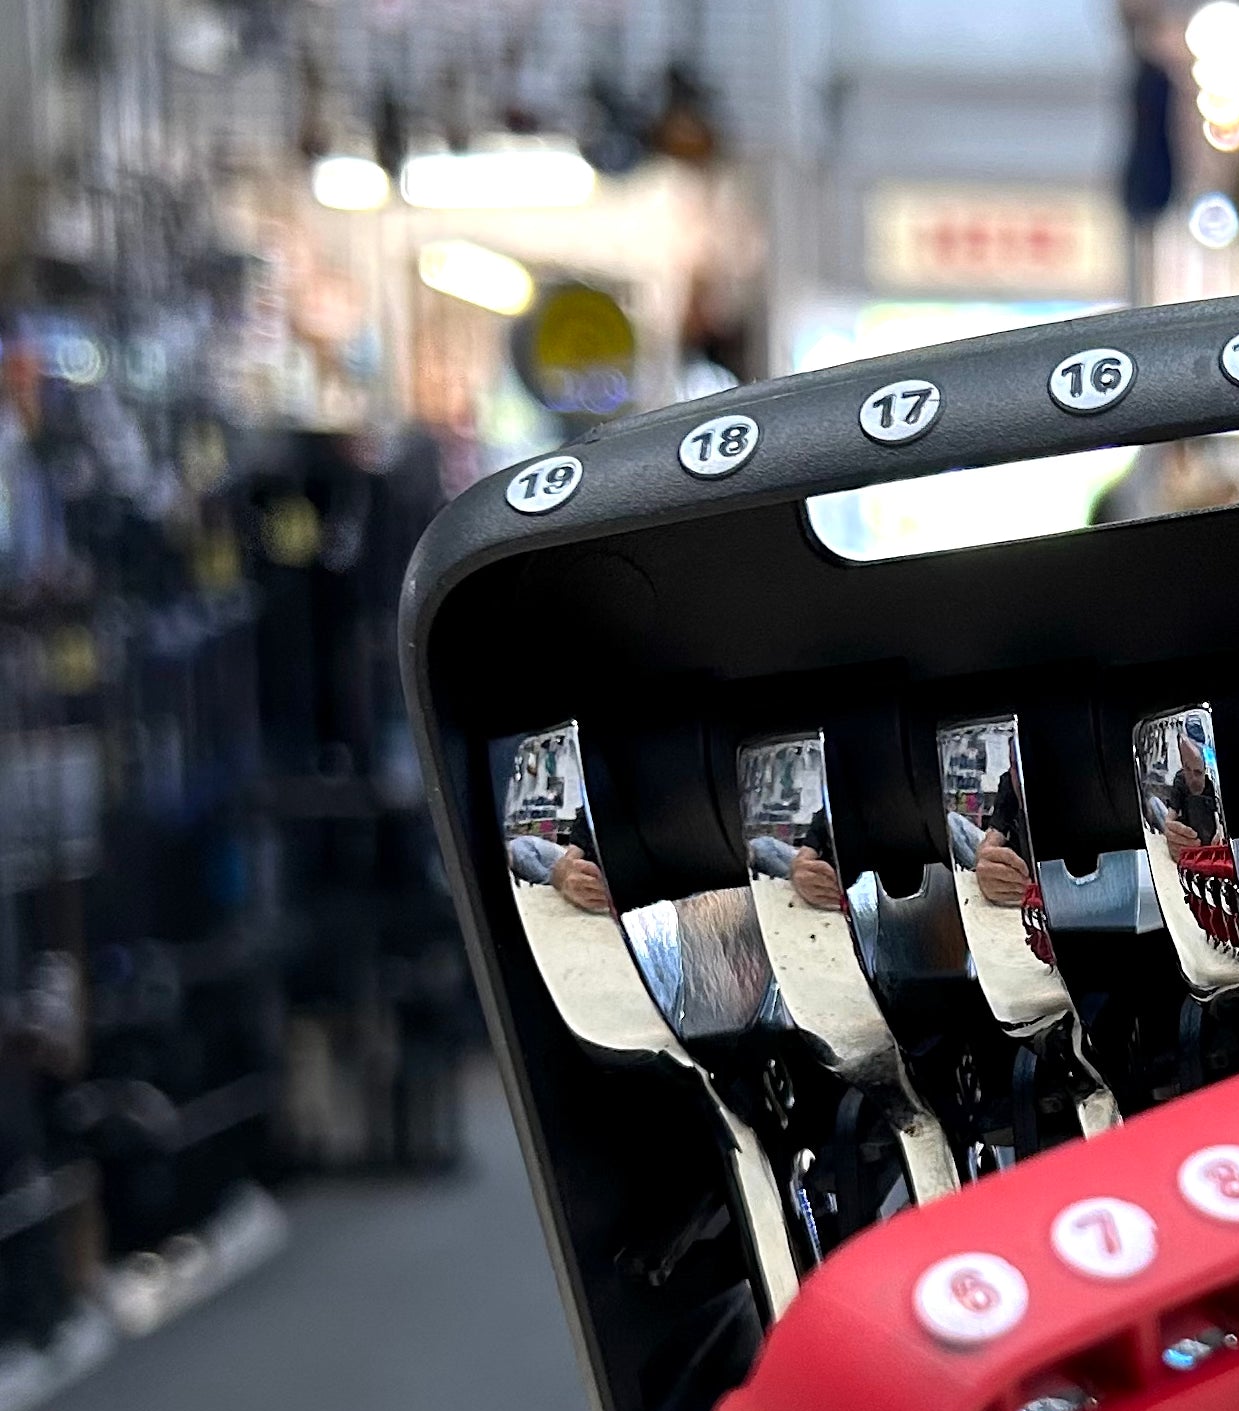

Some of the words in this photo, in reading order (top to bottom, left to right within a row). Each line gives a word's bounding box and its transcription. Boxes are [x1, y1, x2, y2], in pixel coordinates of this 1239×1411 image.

[518, 462, 576, 500] 19
[691, 424, 751, 462] 18
[872, 387, 934, 429] 17
[1060, 357, 1122, 398] 16
[950, 1266, 1001, 1312] 6
[1074, 1208, 1122, 1256] 7
